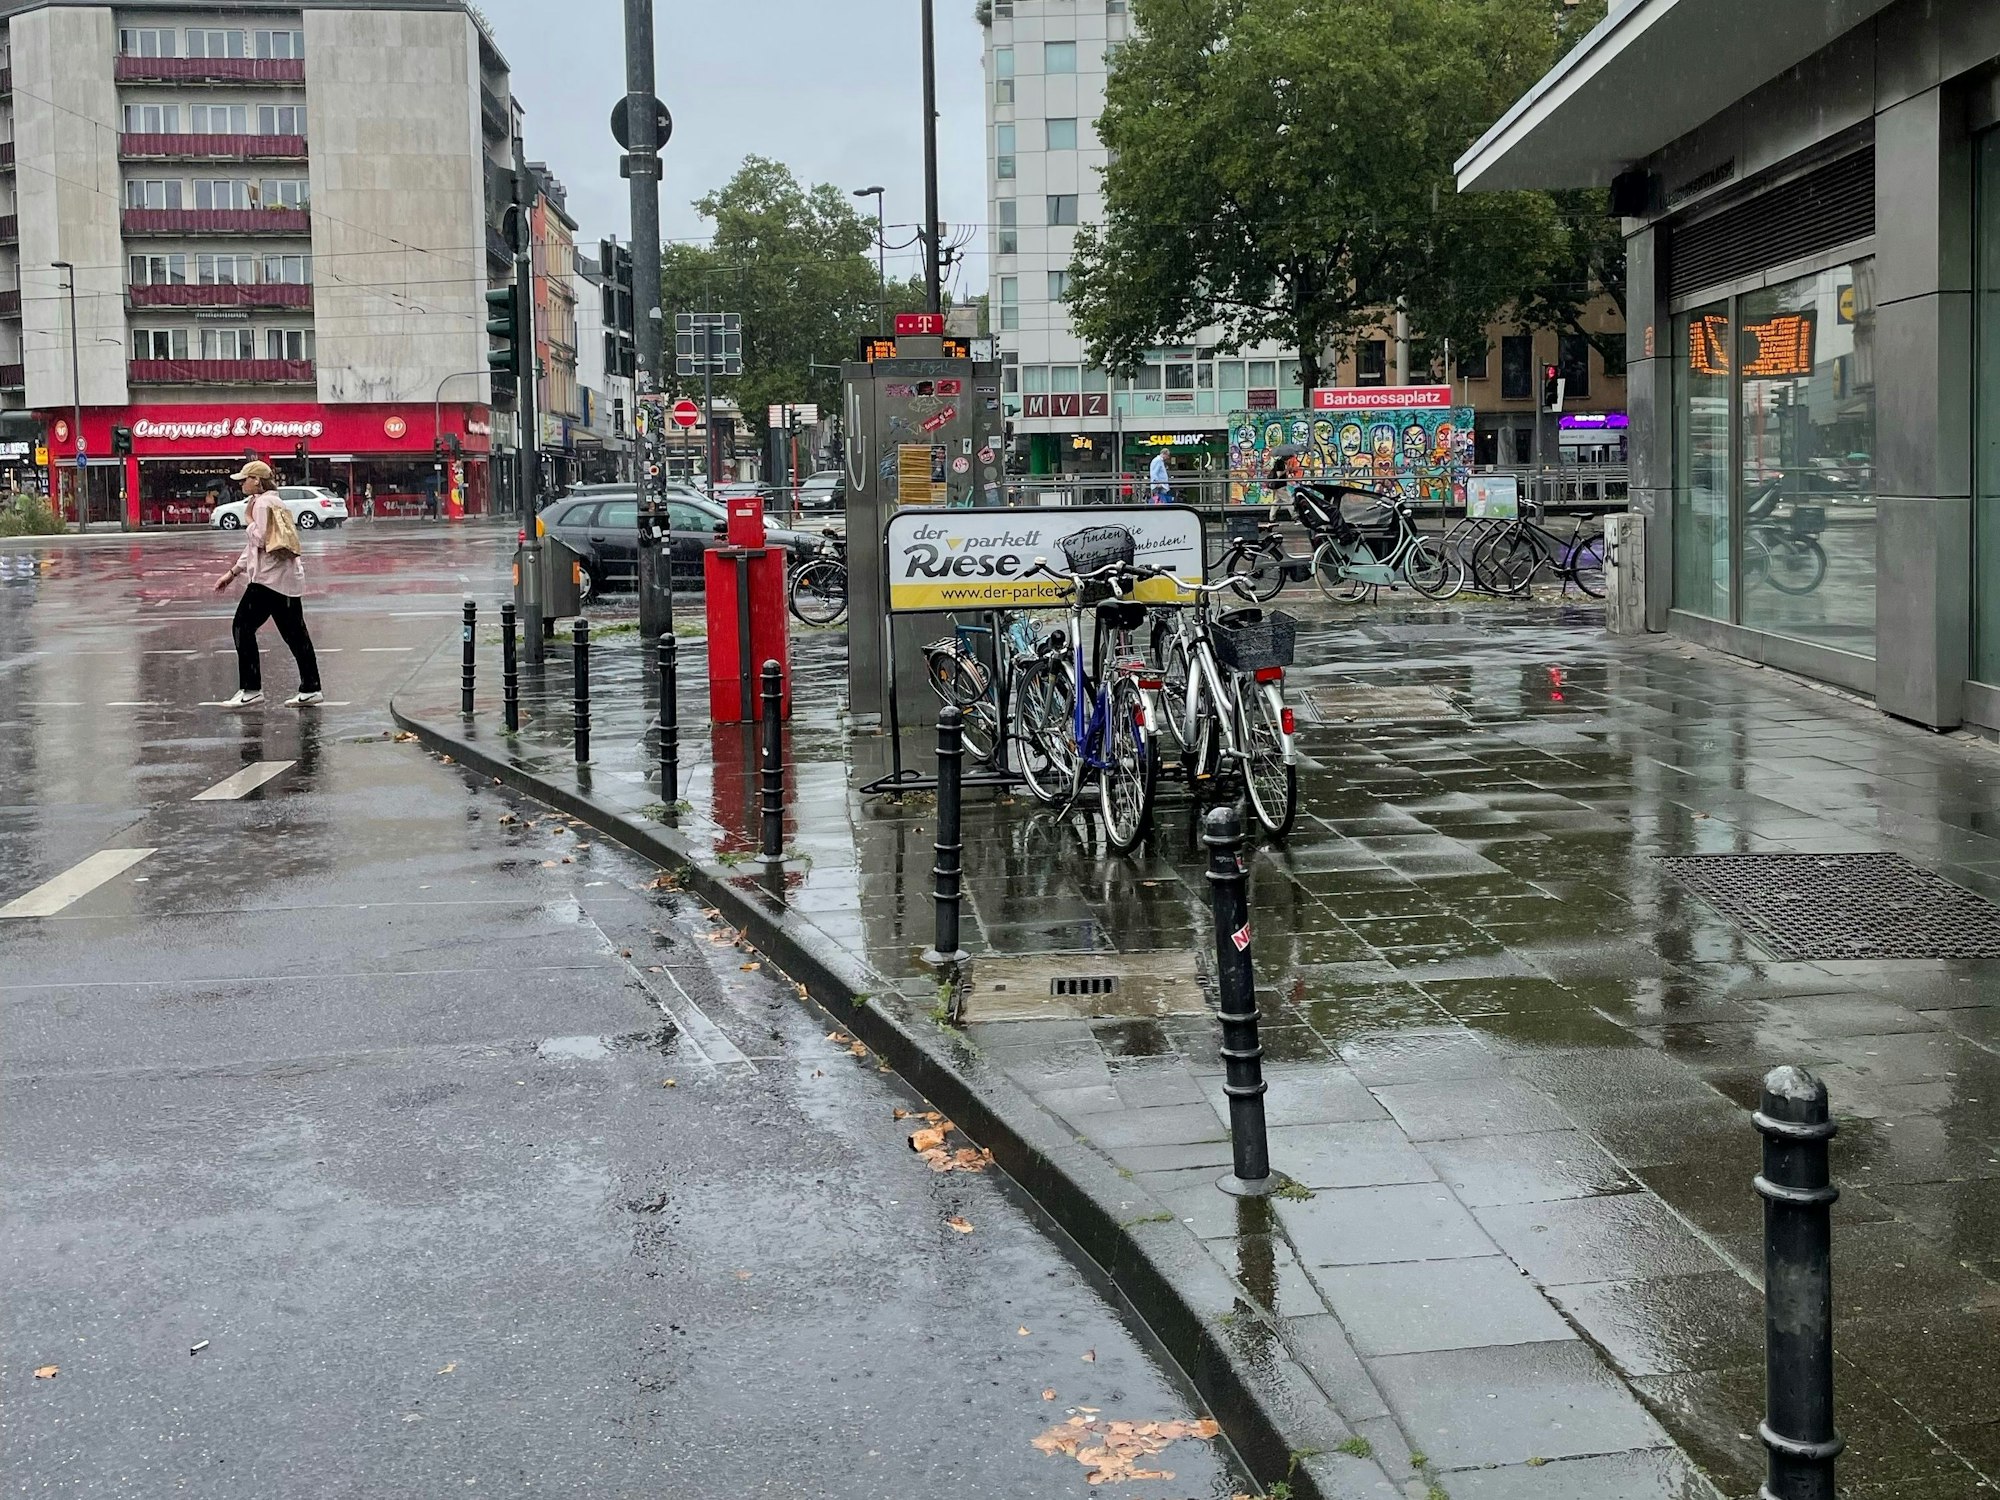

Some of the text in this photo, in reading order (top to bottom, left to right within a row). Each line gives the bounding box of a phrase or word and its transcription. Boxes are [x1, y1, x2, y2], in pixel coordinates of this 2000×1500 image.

[918, 316, 932, 333] T
[1145, 394, 1161, 402] MVZ
[1323, 391, 1441, 406] Barbarossaplatz
[134, 418, 322, 439] Currywurst & Pommes
[1149, 433, 1205, 446] SUBWAY
[913, 524, 1043, 552] der parkett
[1053, 536, 1078, 549] Her
[1082, 529, 1122, 549] finden
[1068, 535, 1187, 561] hren Tramboden!
[903, 543, 1021, 578] Riese
